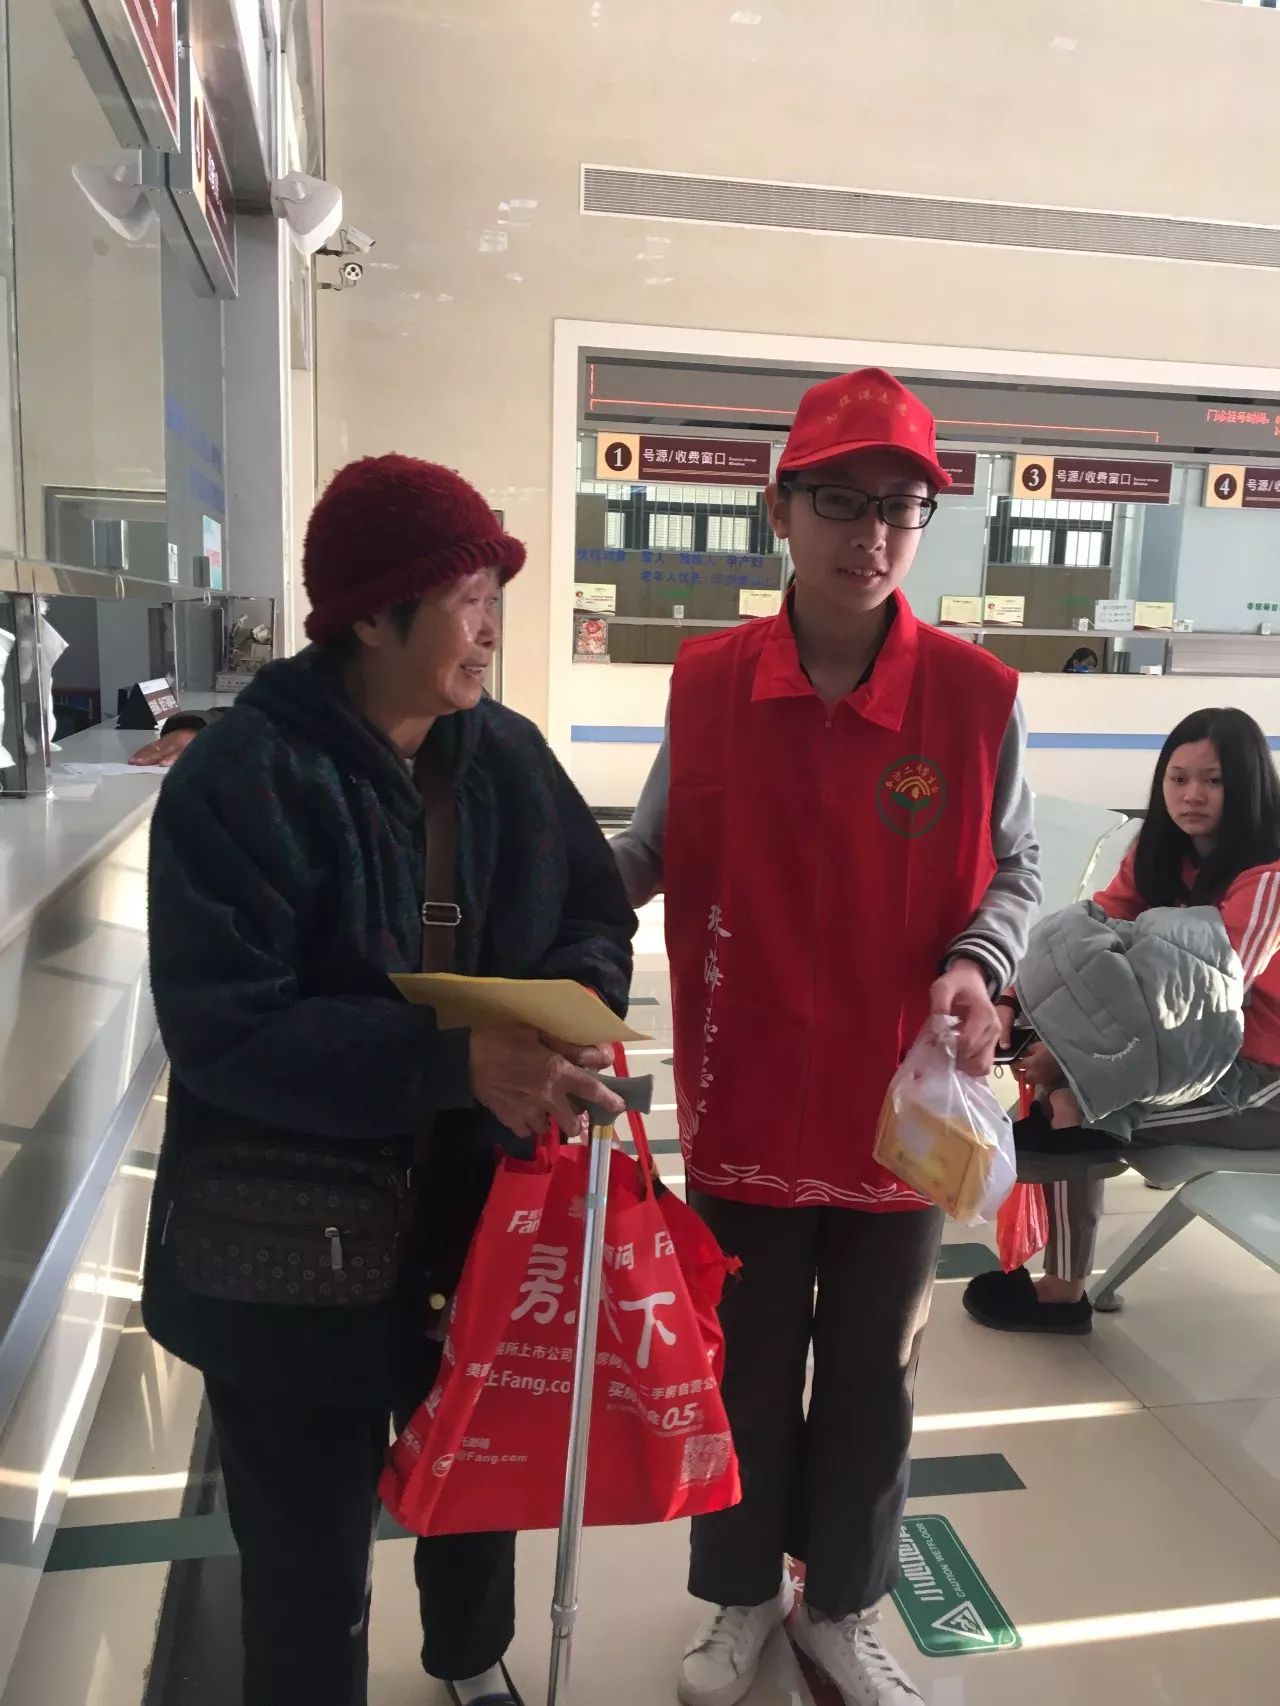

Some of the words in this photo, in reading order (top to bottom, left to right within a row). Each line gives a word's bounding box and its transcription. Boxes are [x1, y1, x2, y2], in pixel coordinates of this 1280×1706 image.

[613, 447, 624, 467] 1
[642, 448, 726, 466] 号源/收费窗口
[1028, 468, 1040, 487] 3
[1055, 469, 1132, 486] 号源/收费窗口
[1219, 477, 1231, 496] 4
[940, 1563, 966, 1598] CAUTION
